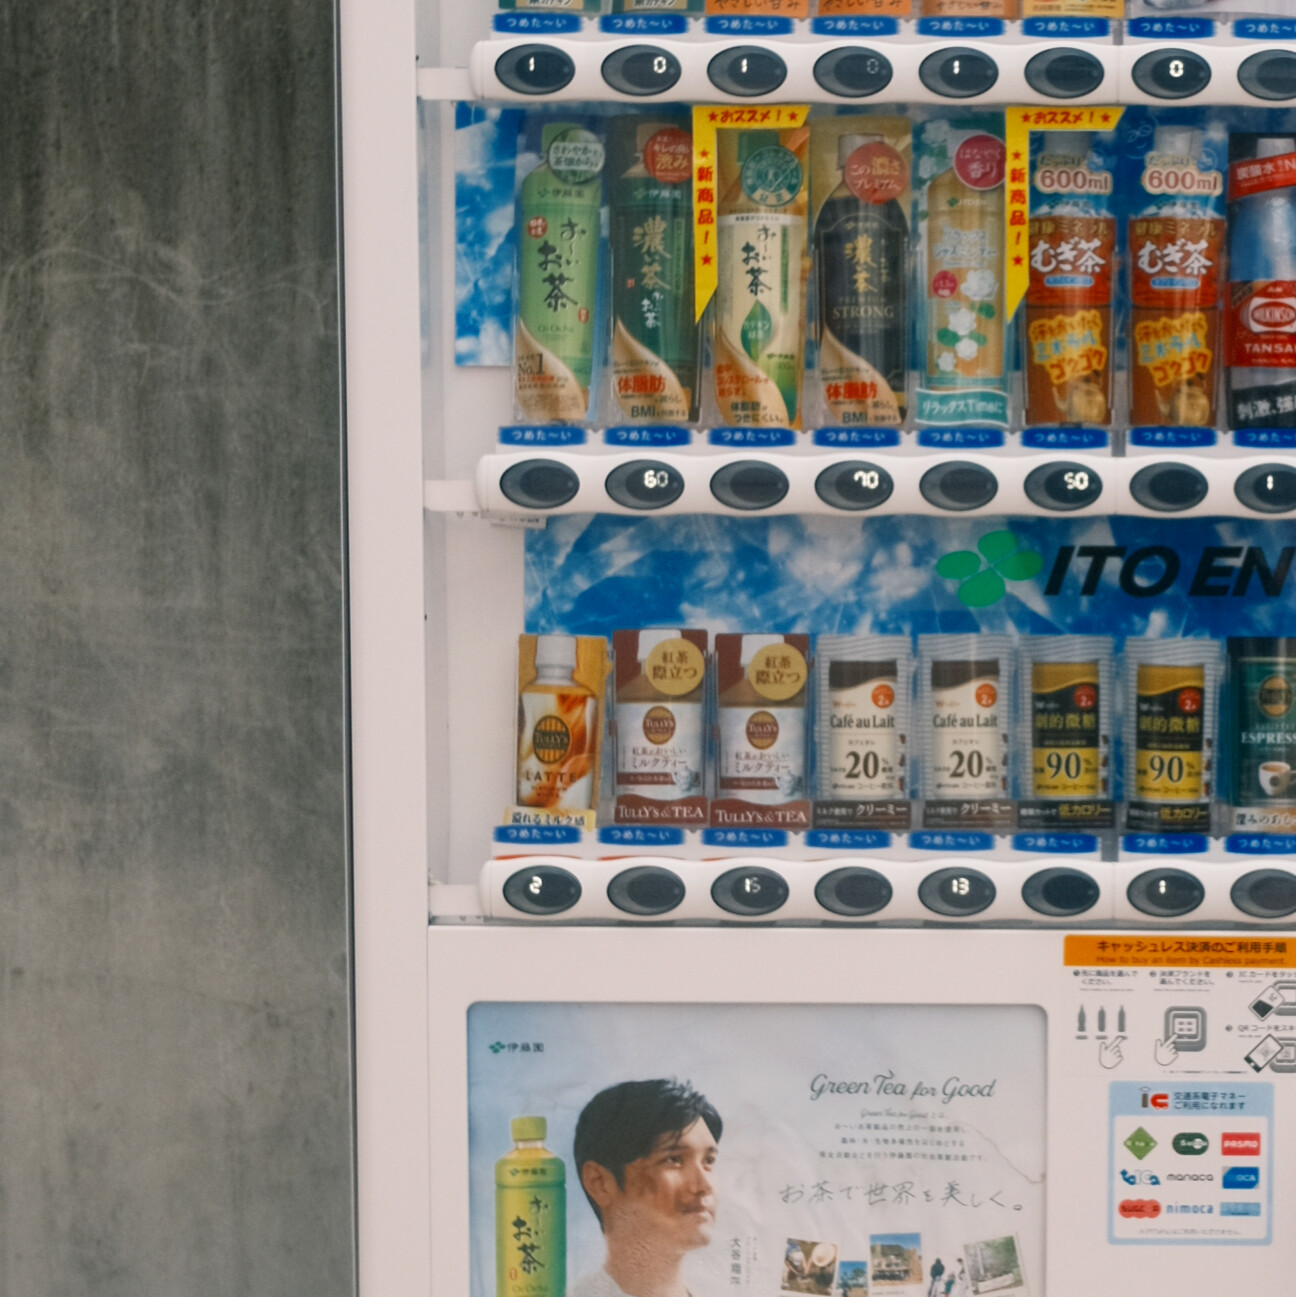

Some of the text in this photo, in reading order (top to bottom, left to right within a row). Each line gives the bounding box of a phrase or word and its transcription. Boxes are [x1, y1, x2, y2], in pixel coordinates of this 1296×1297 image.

[1040, 170, 1110, 192] 600ml
[1148, 171, 1218, 192] 600ml
[1030, 239, 1106, 274] むぎ茶
[1137, 239, 1213, 275] むぎ茶
[833, 306, 893, 320] STRONG
[618, 376, 666, 393] 体脂肪
[631, 406, 655, 417] BMI
[842, 412, 868, 423] BMI
[1043, 544, 1296, 598] ITO EN
[662, 652, 688, 664] 紅茶
[765, 656, 792, 669] 紅茶
[653, 665, 697, 680] 際立つ
[756, 669, 800, 684] 際立つ
[830, 714, 895, 729] Café au Lait
[933, 713, 997, 728] Café au Lait
[845, 751, 880, 779] 20
[949, 751, 984, 778] 20
[1046, 752, 1081, 780] 90
[1150, 756, 1183, 783] 90
[525, 771, 577, 782] LATTE
[810, 1070, 997, 1104] Green Tea for Good
[780, 1180, 1023, 1211] お茶で世界を美しく。
[1166, 1201, 1213, 1214] nimoca
